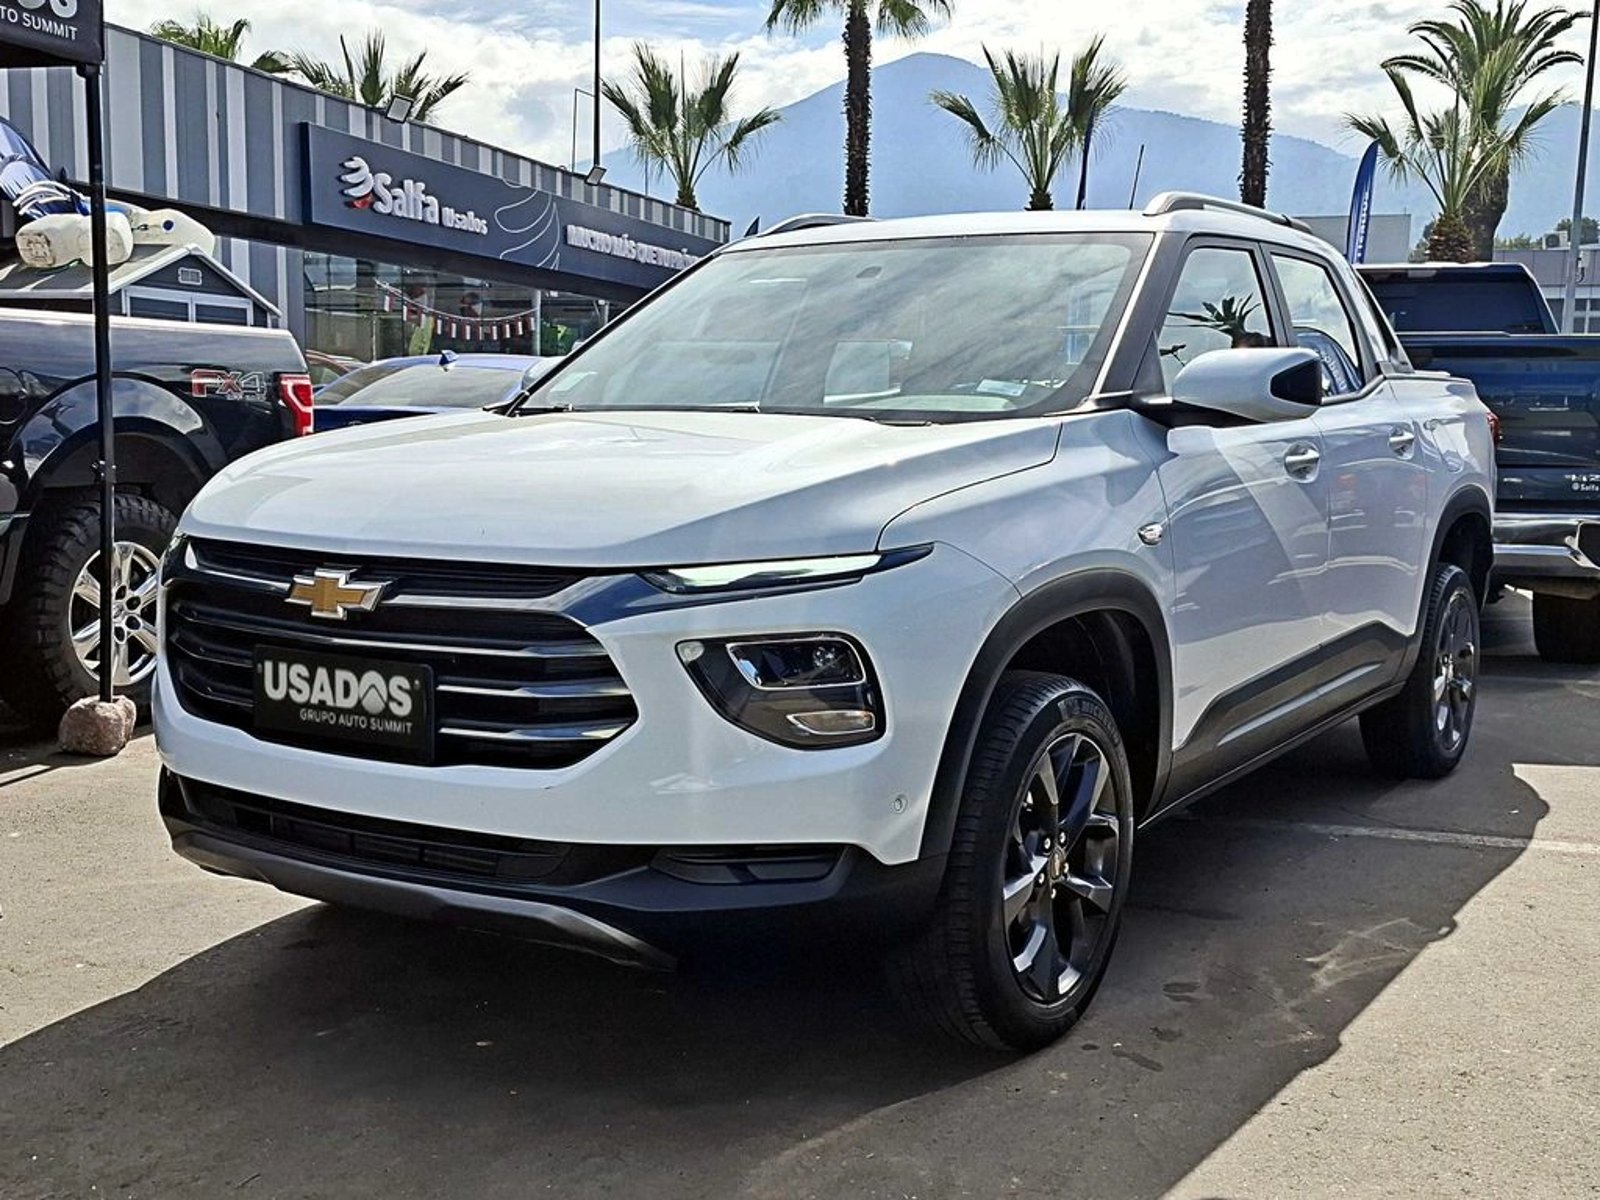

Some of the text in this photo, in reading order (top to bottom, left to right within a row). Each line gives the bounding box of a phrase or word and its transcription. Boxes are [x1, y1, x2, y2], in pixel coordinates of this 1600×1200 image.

[22, 12, 78, 40] SUMMIT
[373, 172, 440, 225] Salfa
[567, 224, 611, 254] MUCHO
[191, 368, 267, 398] FX4
[264, 660, 412, 717] USADOS
[300, 707, 413, 735] GRUPO AUTO SUMMIT
